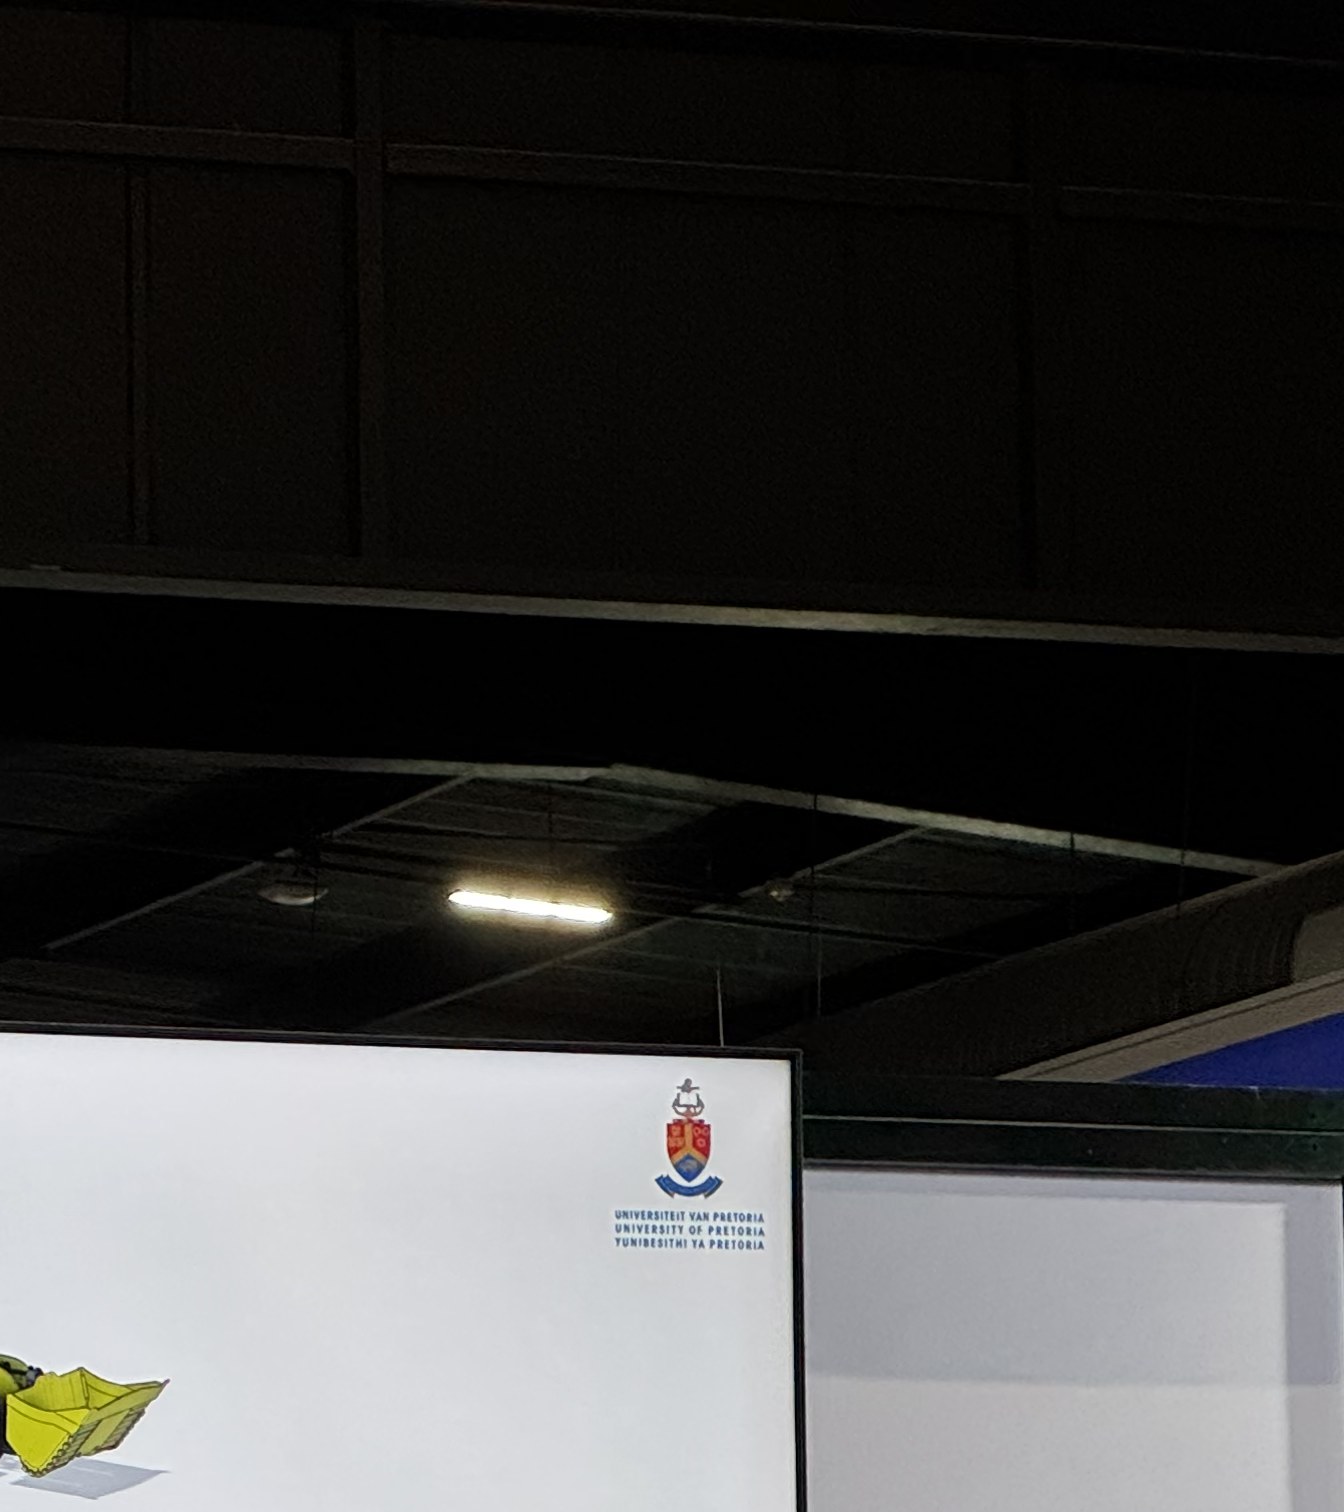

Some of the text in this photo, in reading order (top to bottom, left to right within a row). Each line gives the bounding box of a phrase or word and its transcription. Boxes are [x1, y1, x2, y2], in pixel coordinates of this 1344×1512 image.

[615, 1210, 765, 1223] UNIVERSITEIT VAN PRETORIA
[615, 1224, 765, 1236] UNIVERSITY OF PRETORIA
[709, 1240, 765, 1250] PRETORIA
